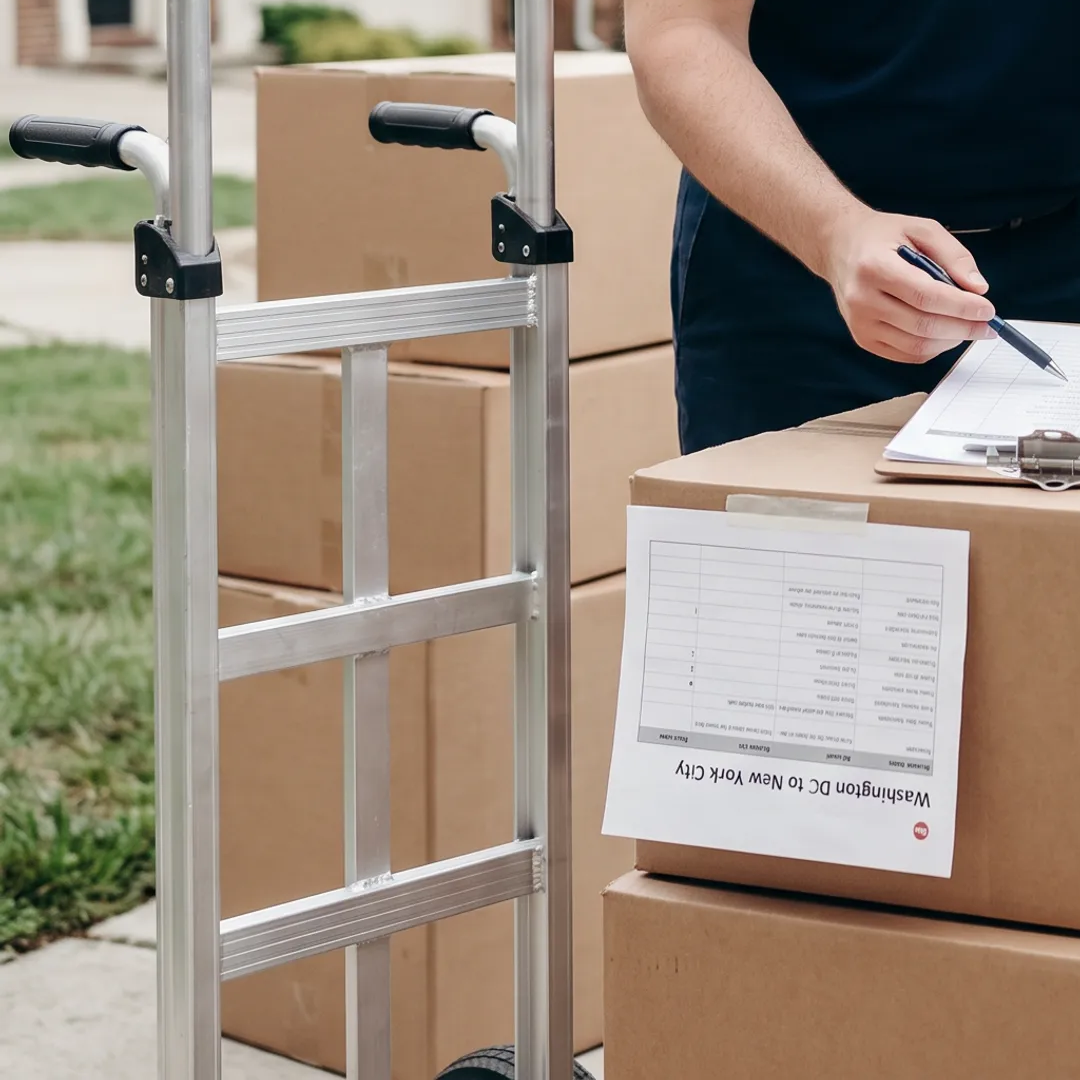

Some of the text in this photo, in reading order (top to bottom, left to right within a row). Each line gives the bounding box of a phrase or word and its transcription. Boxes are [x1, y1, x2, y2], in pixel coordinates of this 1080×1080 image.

[675, 759, 931, 808] Washington DC to New York City
